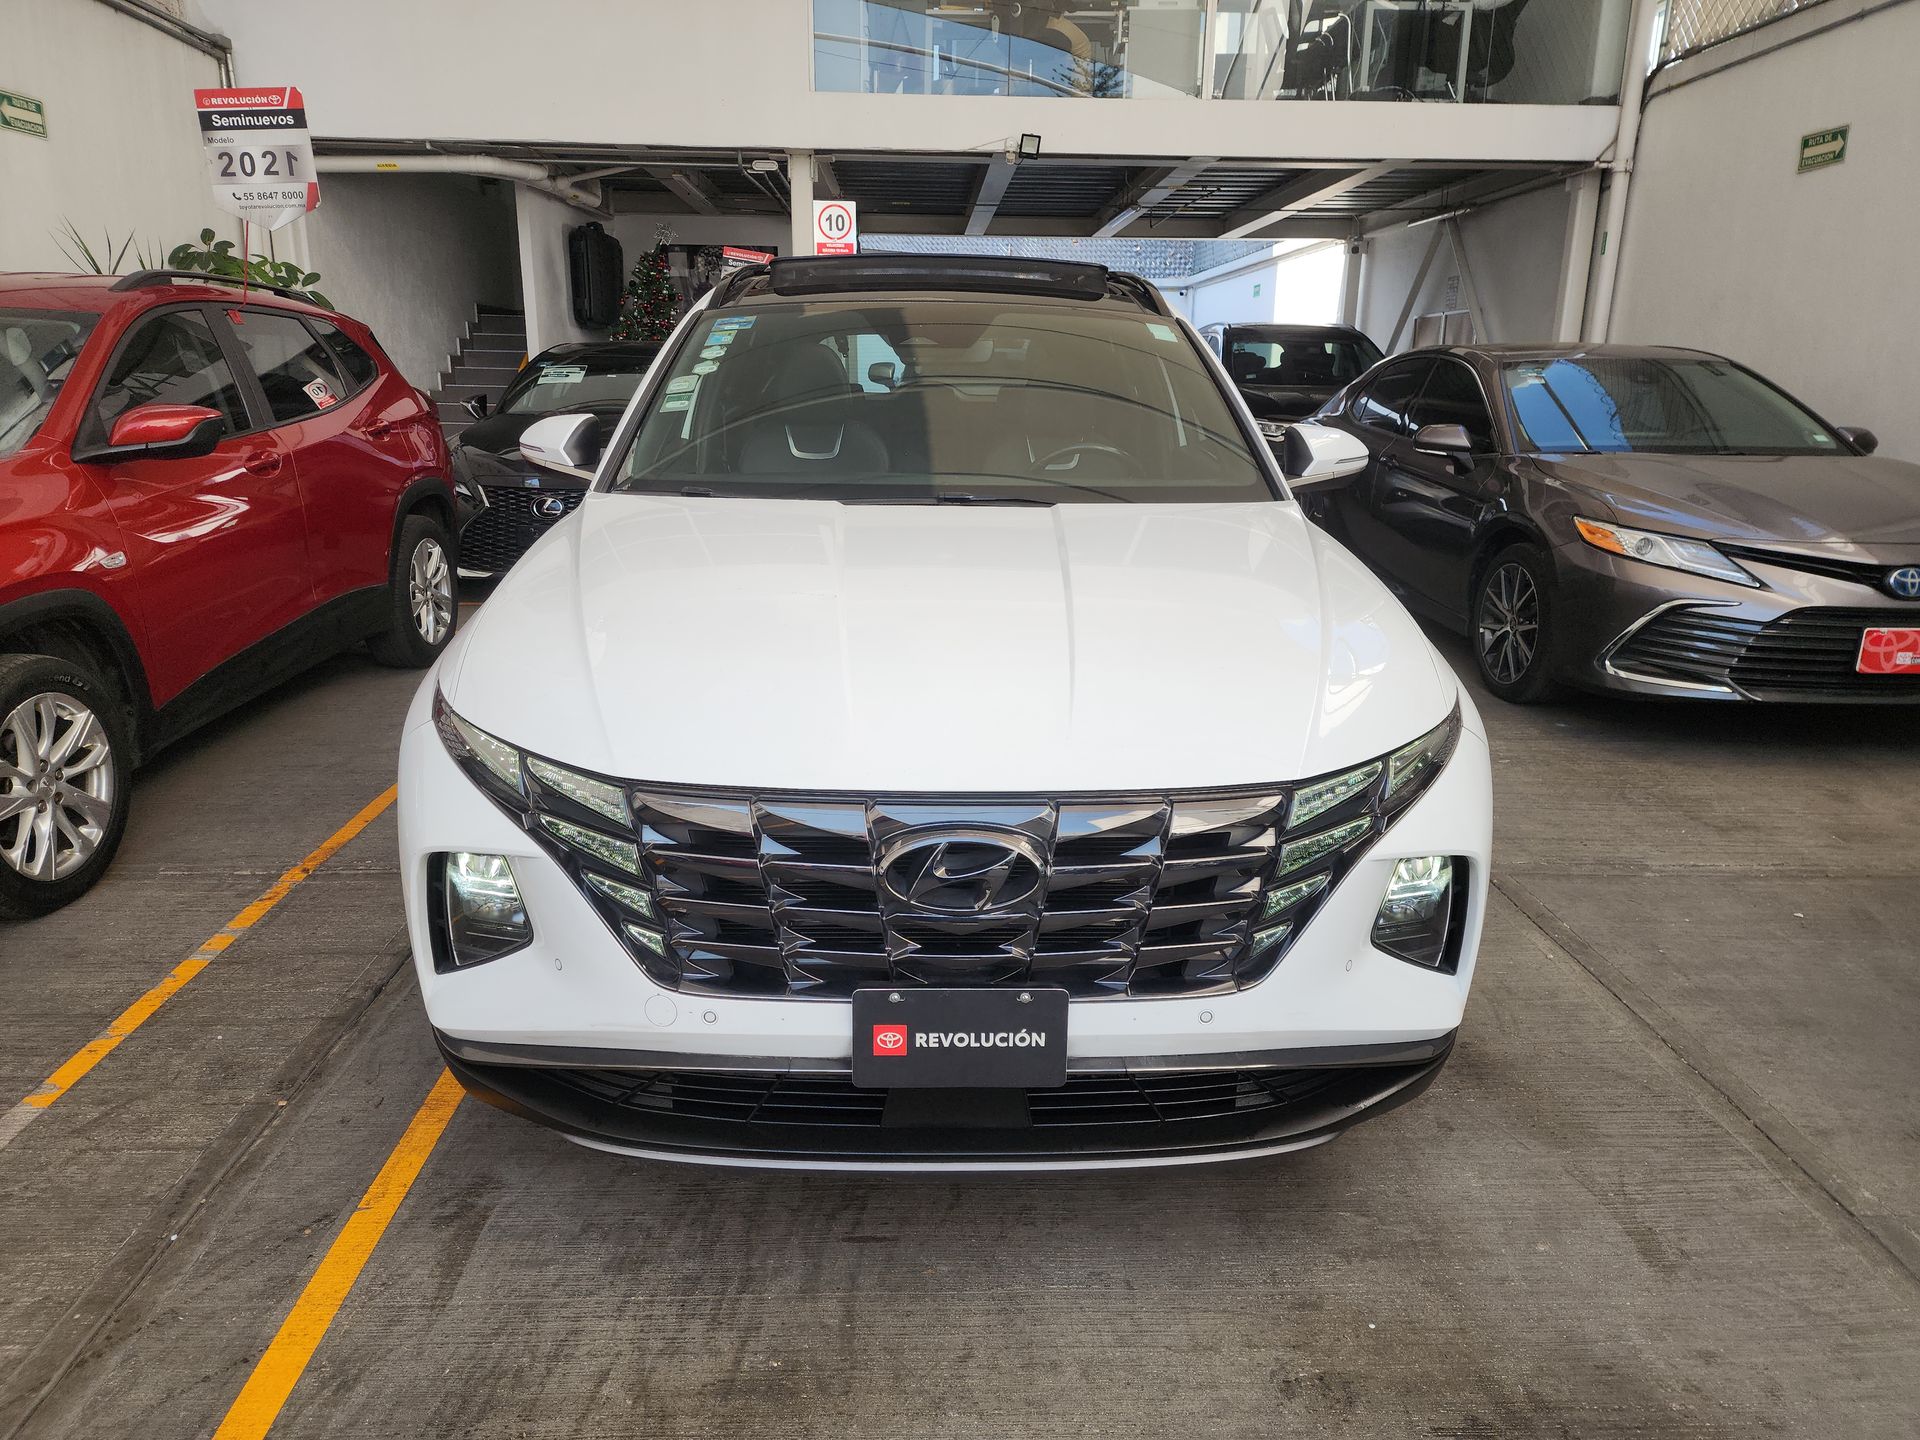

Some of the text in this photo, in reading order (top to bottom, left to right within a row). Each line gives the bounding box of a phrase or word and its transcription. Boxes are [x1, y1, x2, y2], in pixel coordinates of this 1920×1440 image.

[211, 95, 267, 105] REVOLUCIÓN
[212, 114, 294, 127] Seminuevos
[1809, 133, 1833, 146] RUTA DE
[217, 150, 298, 177] 2021
[243, 190, 304, 201] 55 8647 8000
[825, 213, 845, 231] 10
[915, 1029, 1046, 1048] REVOLUCIÓN
